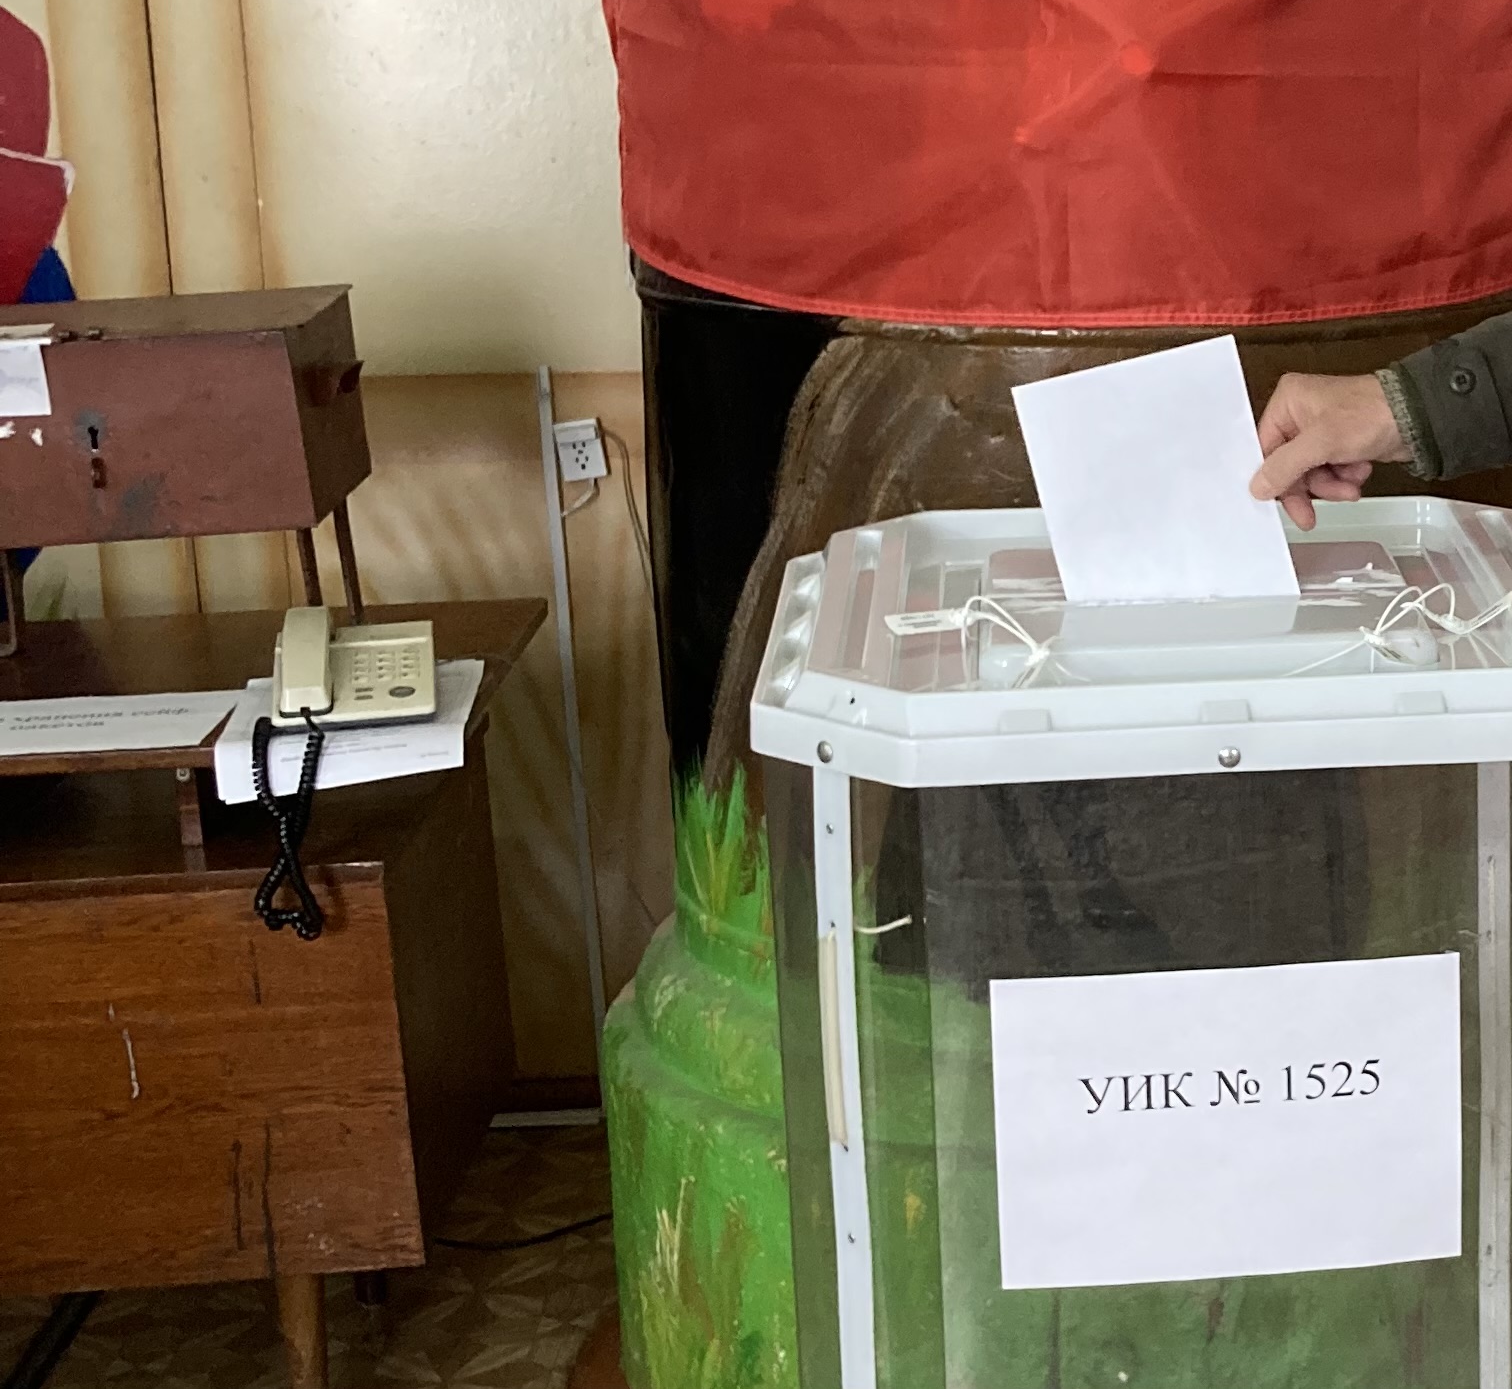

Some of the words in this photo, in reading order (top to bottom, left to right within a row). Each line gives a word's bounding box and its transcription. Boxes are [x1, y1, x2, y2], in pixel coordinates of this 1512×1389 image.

[1078, 1071, 1194, 1115] УИК
[1210, 1069, 1261, 1107] №
[1283, 1058, 1381, 1101] 1525
